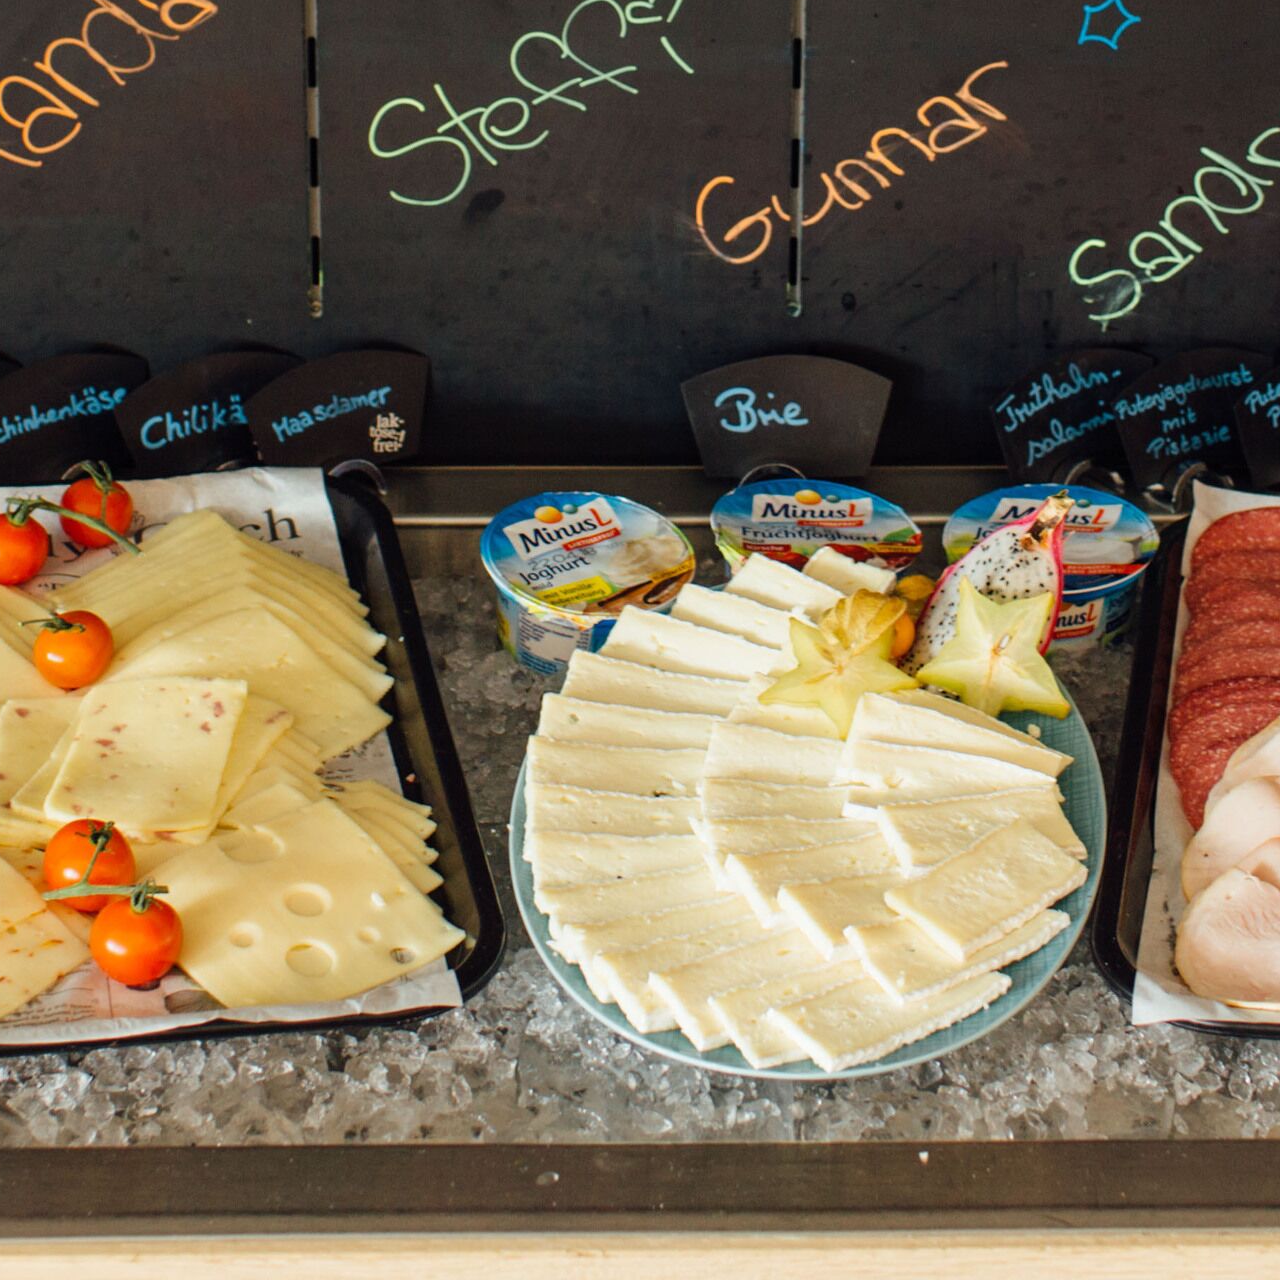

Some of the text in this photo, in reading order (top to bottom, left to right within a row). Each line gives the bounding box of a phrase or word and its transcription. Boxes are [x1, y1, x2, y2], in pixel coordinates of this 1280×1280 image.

[694, 59, 1009, 265] Gunnar
[140, 394, 249, 450] Chilikä
[714, 386, 810, 433] Brie
[1161, 407, 1197, 433] mit
[1145, 424, 1232, 459] Pistazie
[518, 507, 613, 553] MinusL
[761, 502, 865, 519] MinusL
[519, 556, 592, 586] Joghurt
